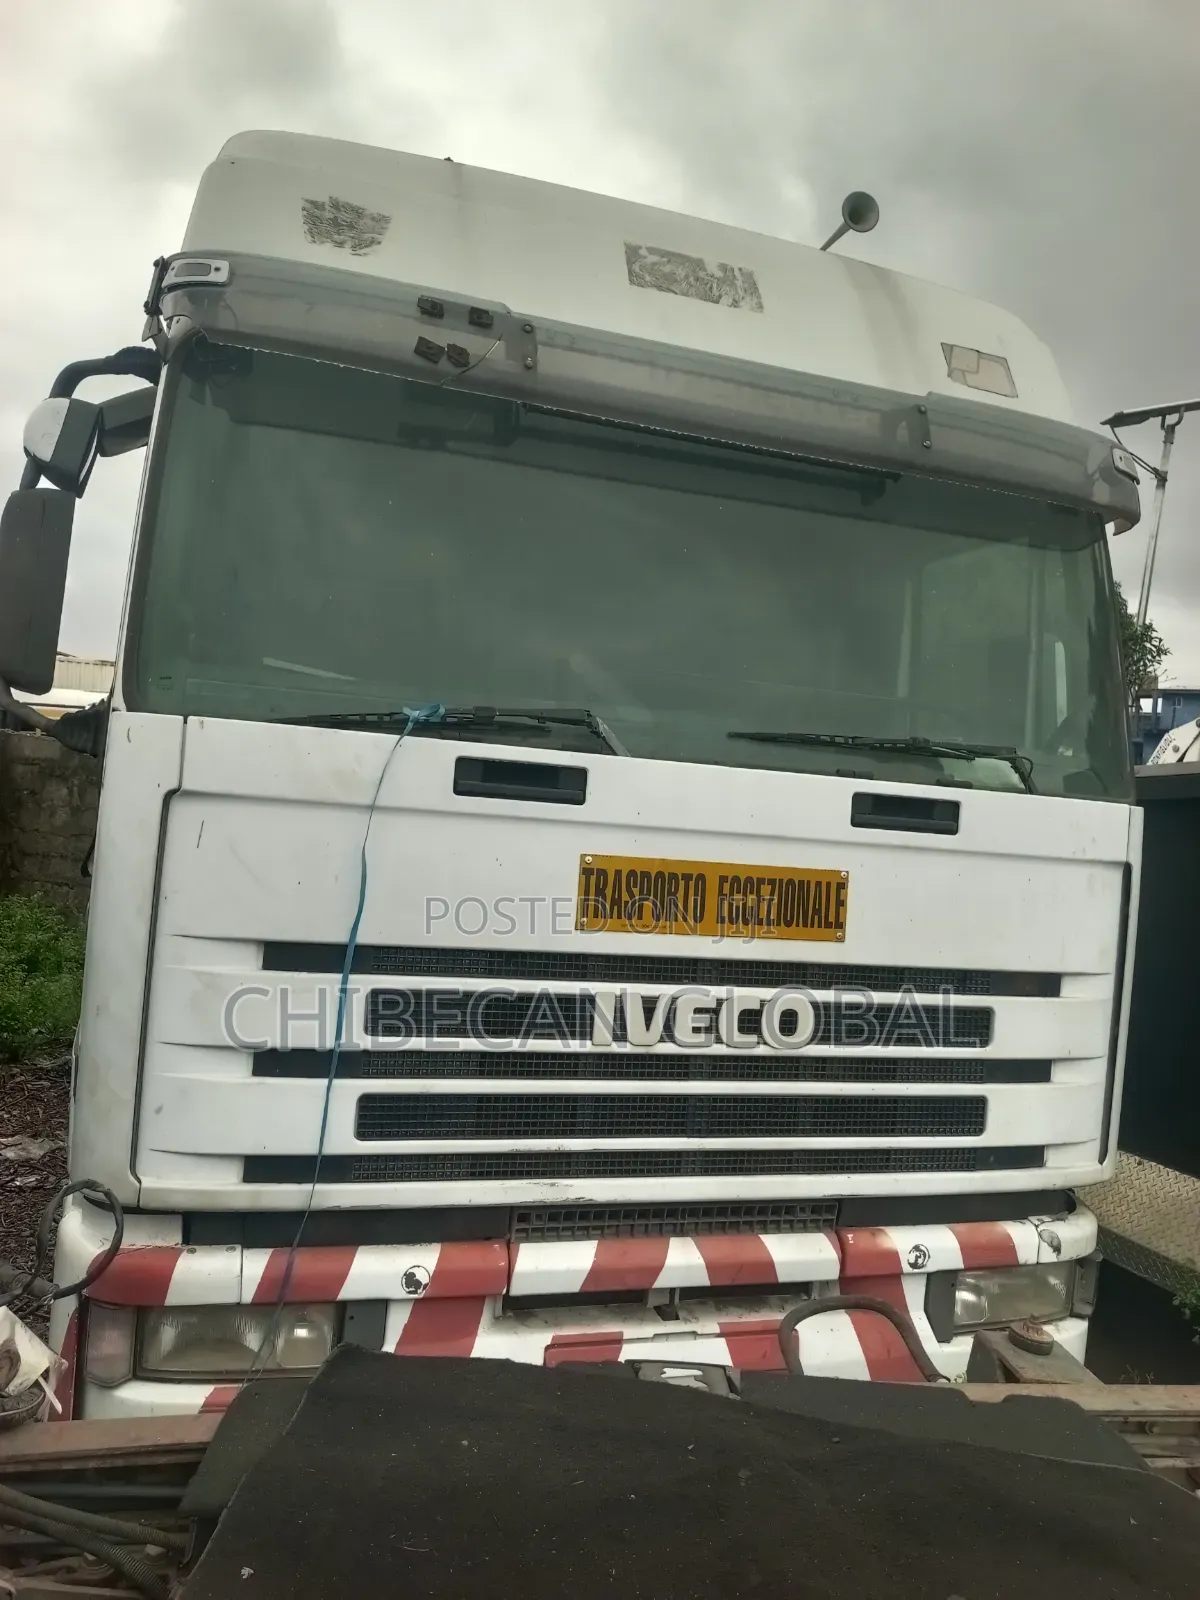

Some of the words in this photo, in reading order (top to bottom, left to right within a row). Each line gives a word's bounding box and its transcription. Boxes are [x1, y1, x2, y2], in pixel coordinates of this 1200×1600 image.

[580, 866, 707, 924] TRASPORTO
[716, 874, 846, 930] ECCEZIONALE
[591, 991, 816, 1049] IVECO
